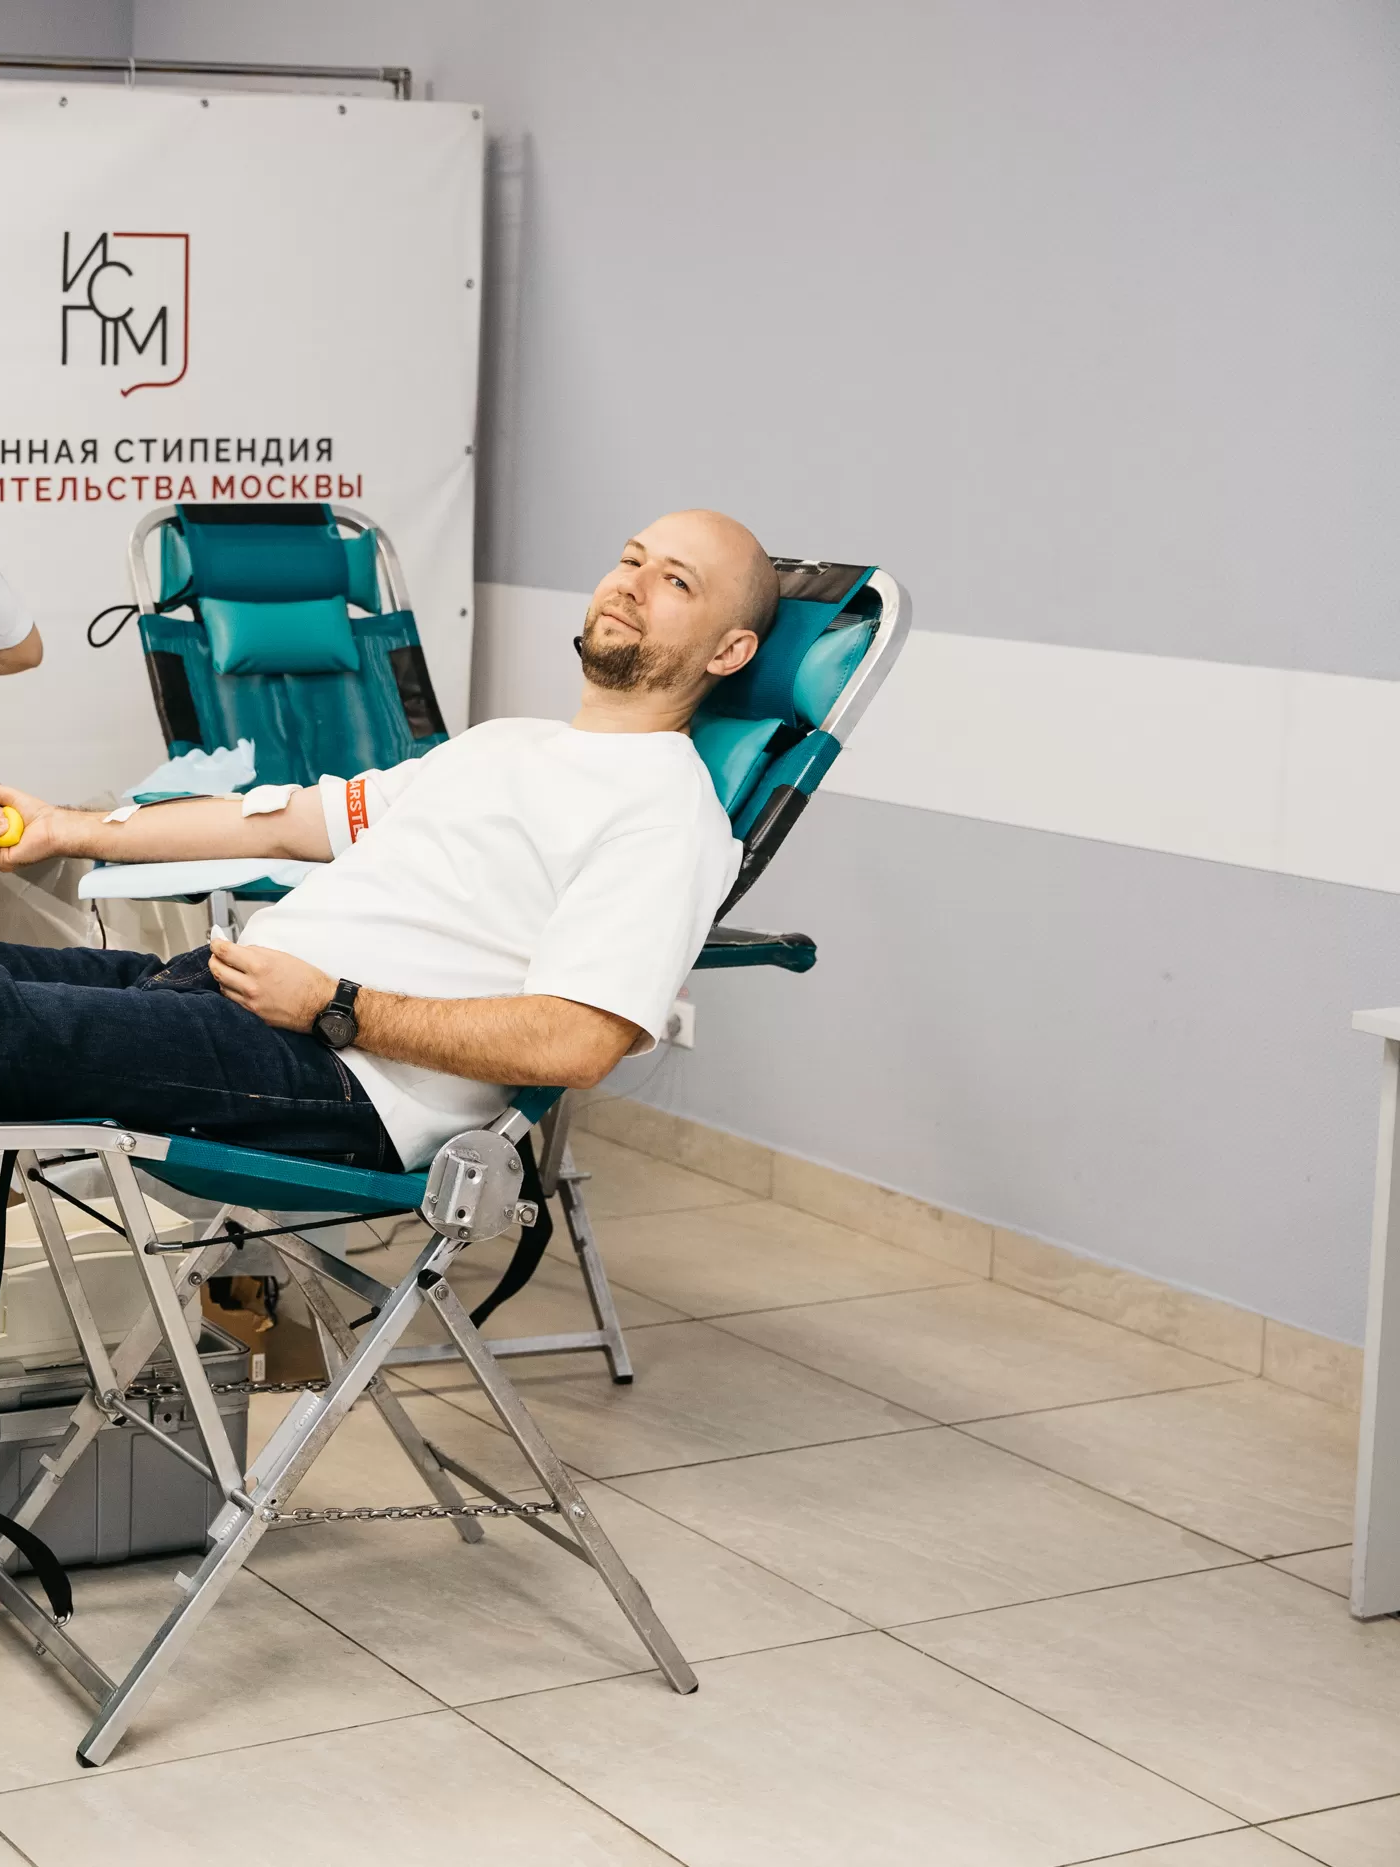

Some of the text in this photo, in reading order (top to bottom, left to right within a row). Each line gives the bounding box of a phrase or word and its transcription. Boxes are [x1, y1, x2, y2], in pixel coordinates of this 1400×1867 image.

[115, 438, 332, 466] СТИПЕНДИЯ
[211, 474, 363, 500] МОСКВЫ
[346, 779, 366, 839] ARSTE
